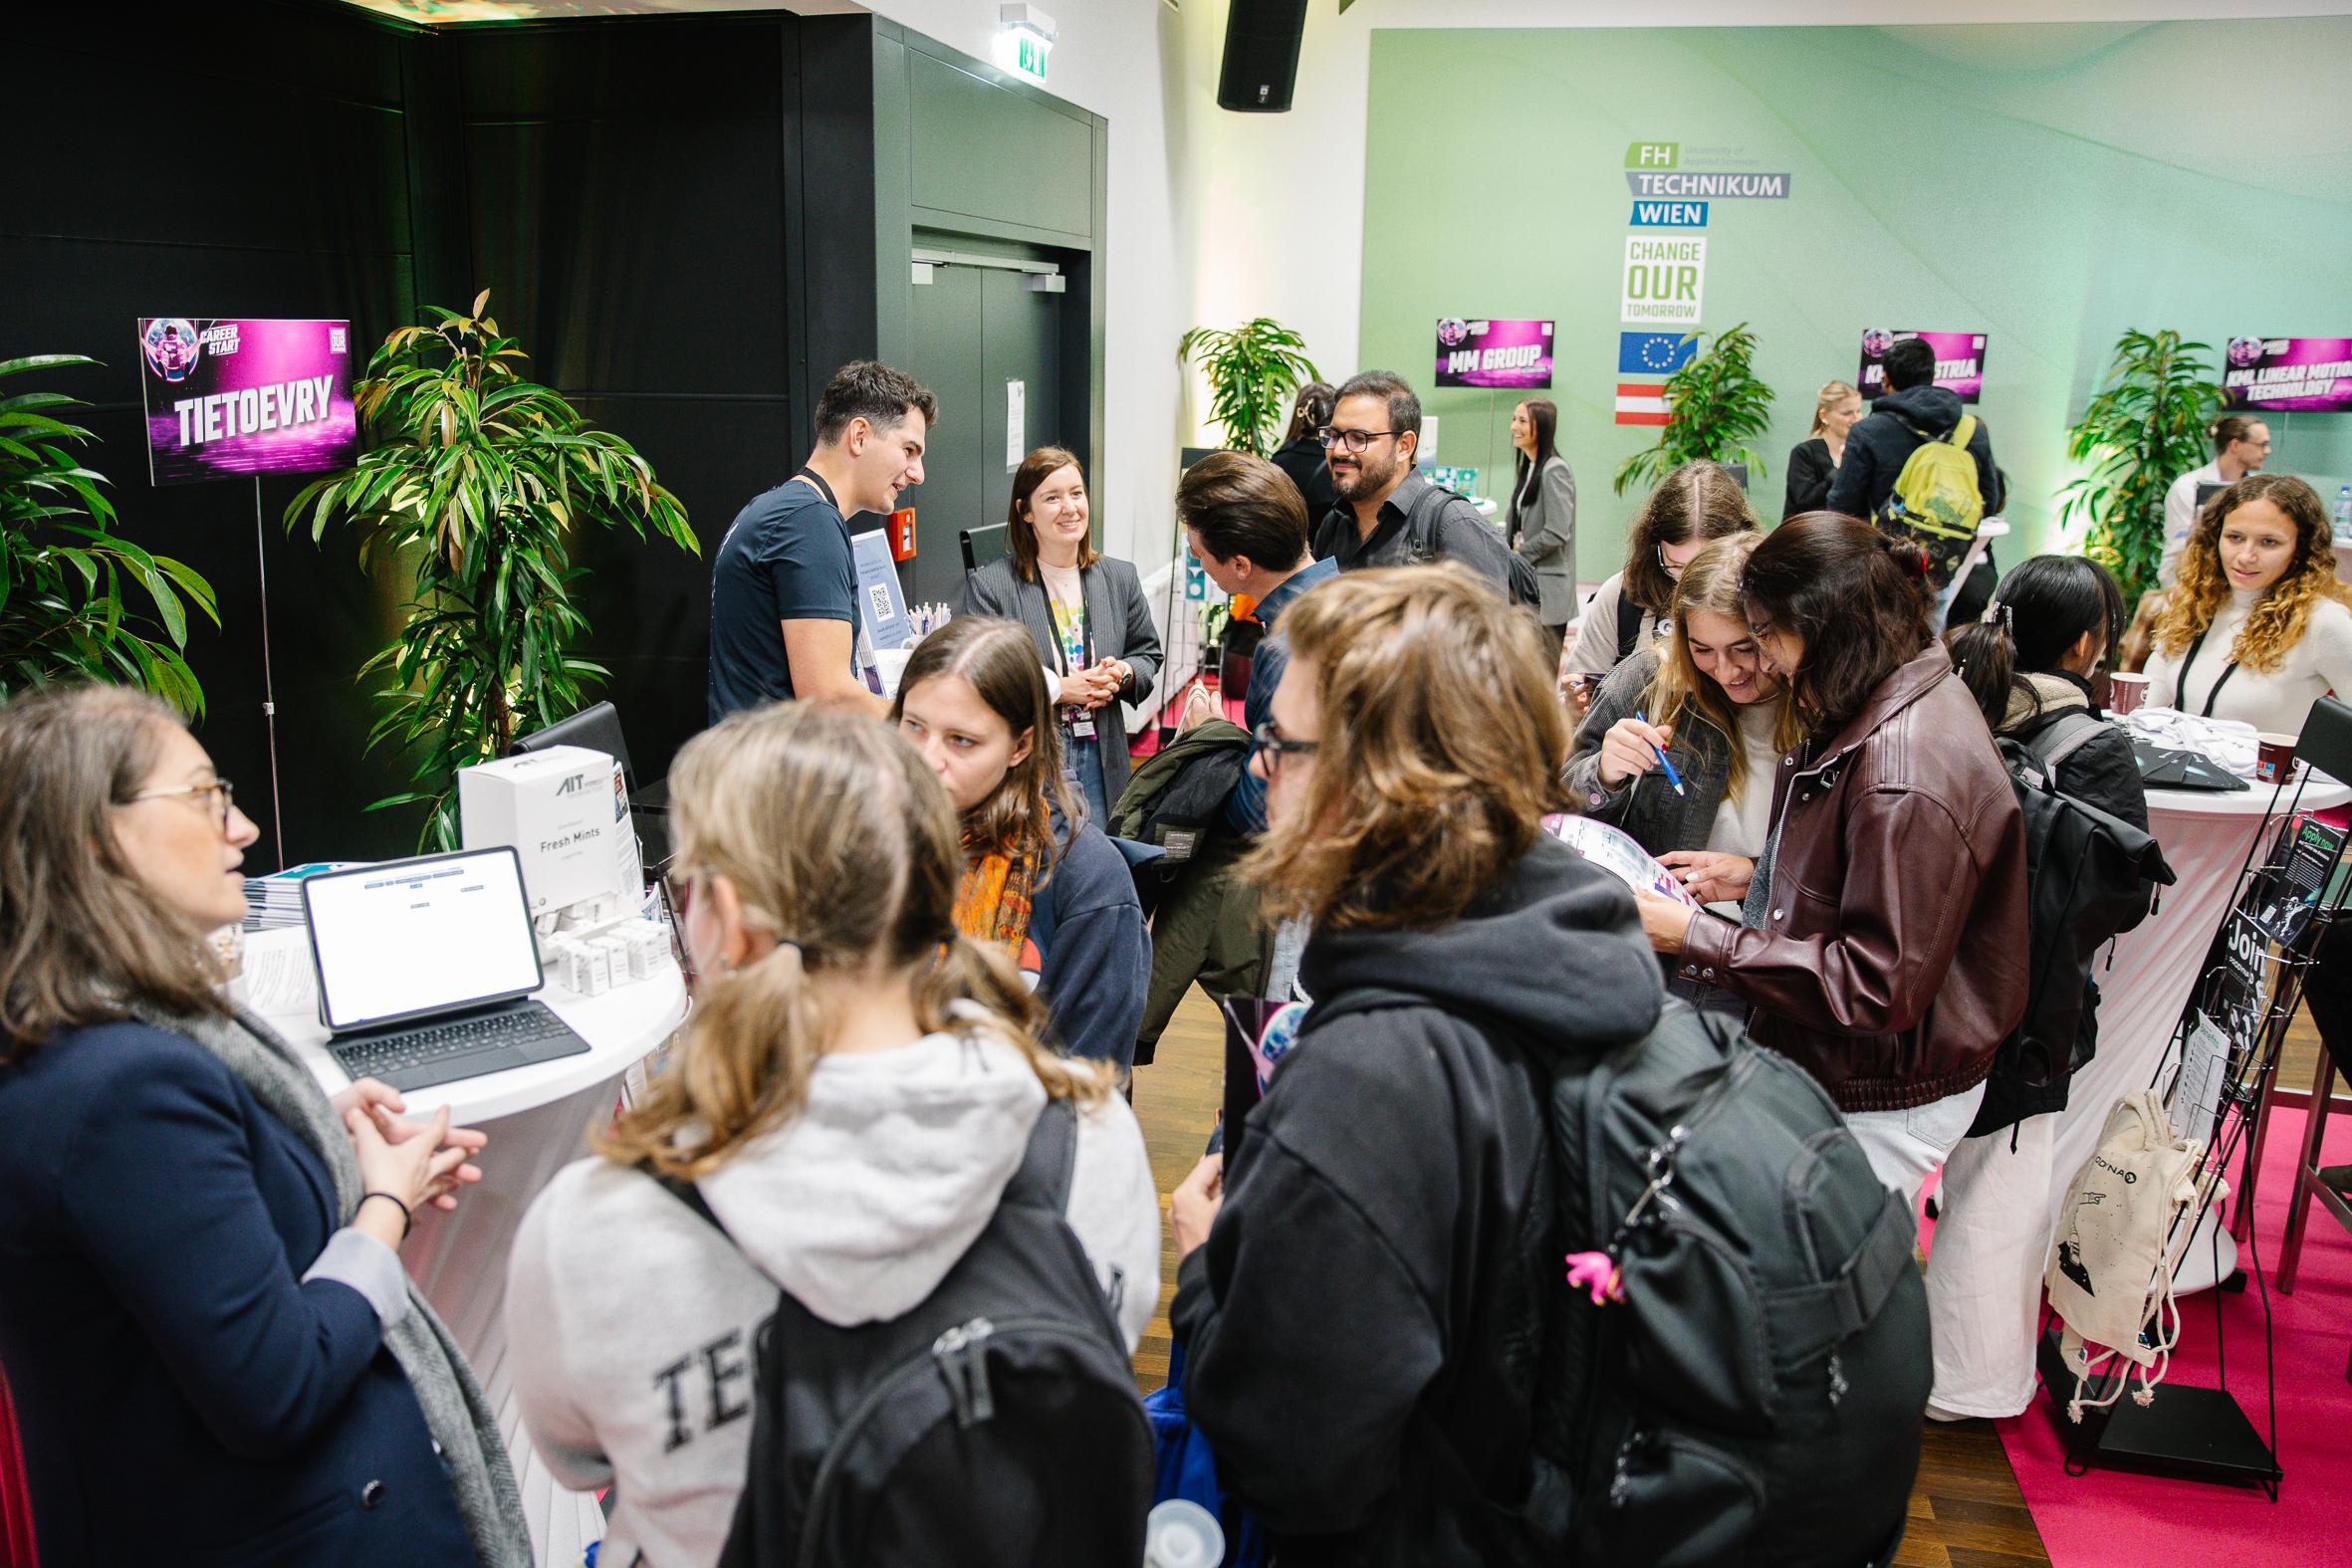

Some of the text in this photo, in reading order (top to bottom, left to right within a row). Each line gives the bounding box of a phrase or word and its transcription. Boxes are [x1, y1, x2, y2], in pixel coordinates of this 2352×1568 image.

[1639, 145, 1671, 166] FH
[1638, 174, 1782, 196] TECHNIKUM
[1638, 203, 1702, 224] WIEN
[1629, 241, 1701, 261] CHANGE
[1627, 265, 1698, 301] OUR
[1627, 304, 1697, 318] TOMORROW
[200, 326, 238, 343] CAREER
[208, 336, 241, 355] START
[1447, 344, 1542, 373] MM GROUP
[174, 374, 334, 446] TIETOEVRY
[540, 827, 600, 853] Fresh Mints
[2228, 918, 2266, 977] Join
